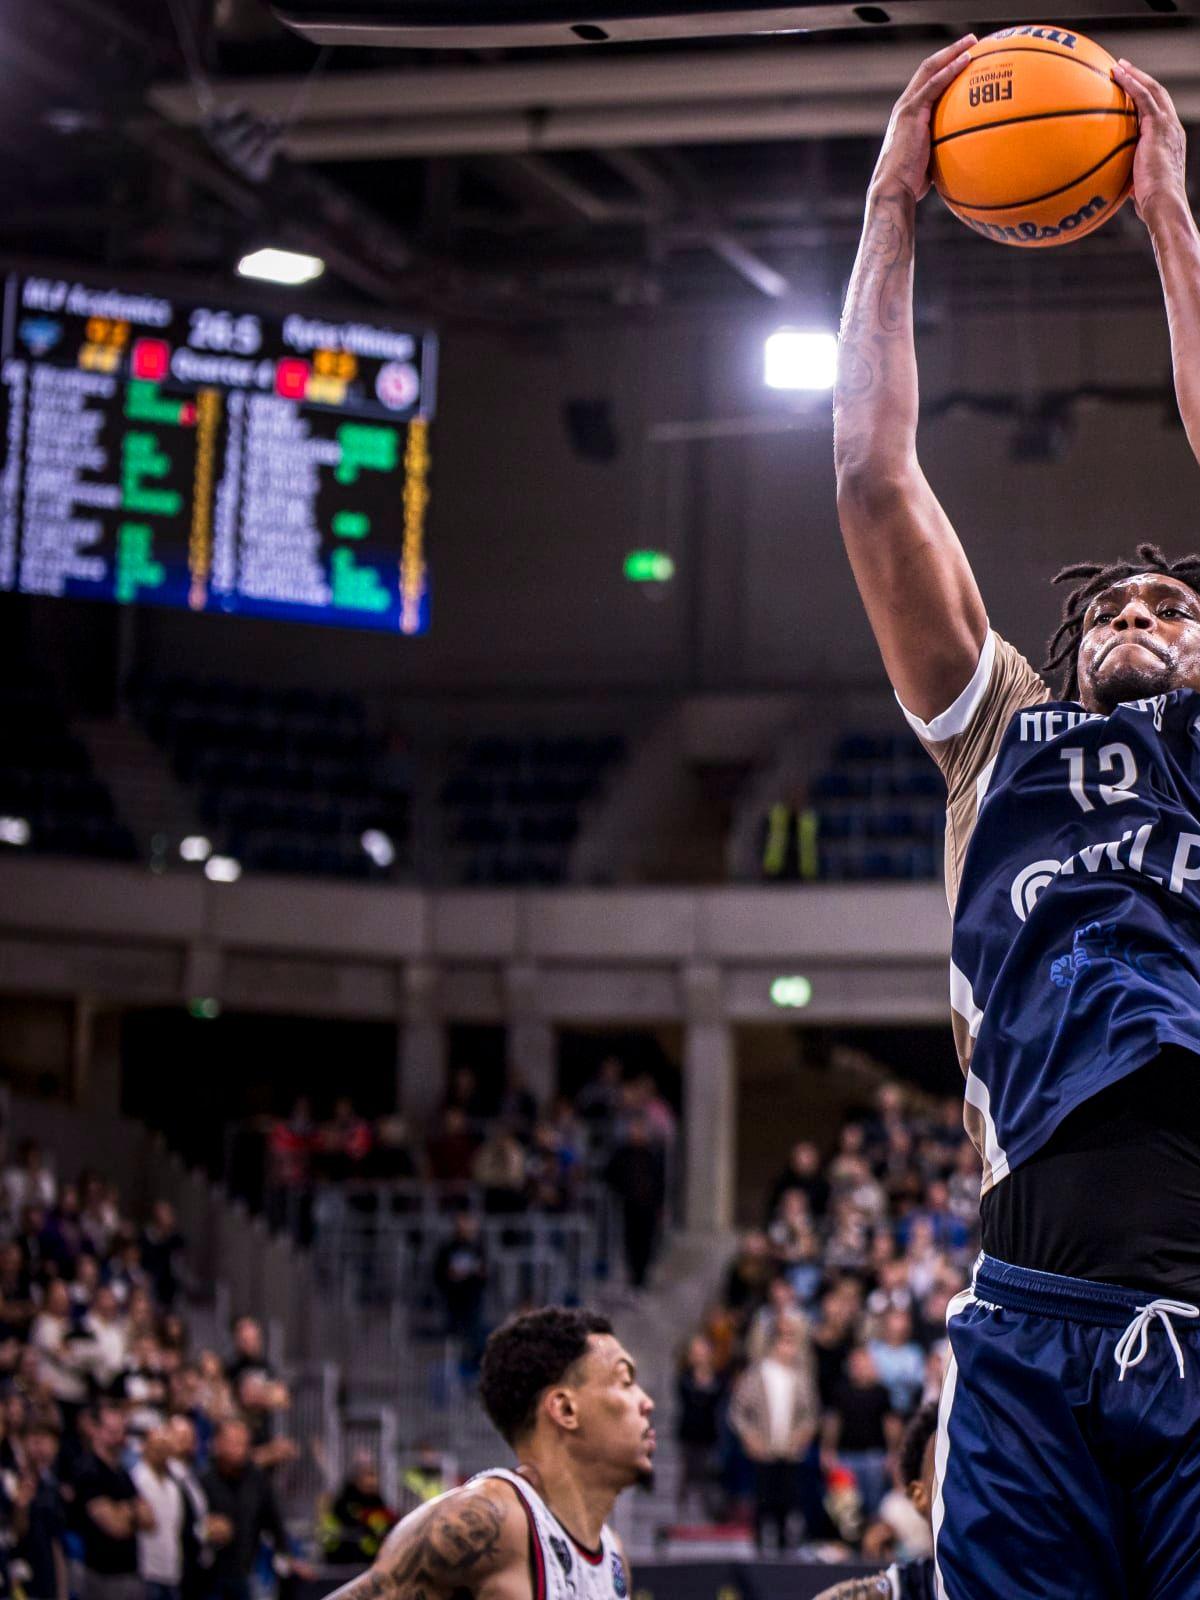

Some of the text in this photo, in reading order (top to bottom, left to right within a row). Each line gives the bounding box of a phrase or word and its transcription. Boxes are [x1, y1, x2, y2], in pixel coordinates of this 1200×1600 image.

[969, 70, 1012, 86] APPROVED
[969, 80, 1012, 107] FIBA
[1060, 742, 1140, 814] 12
